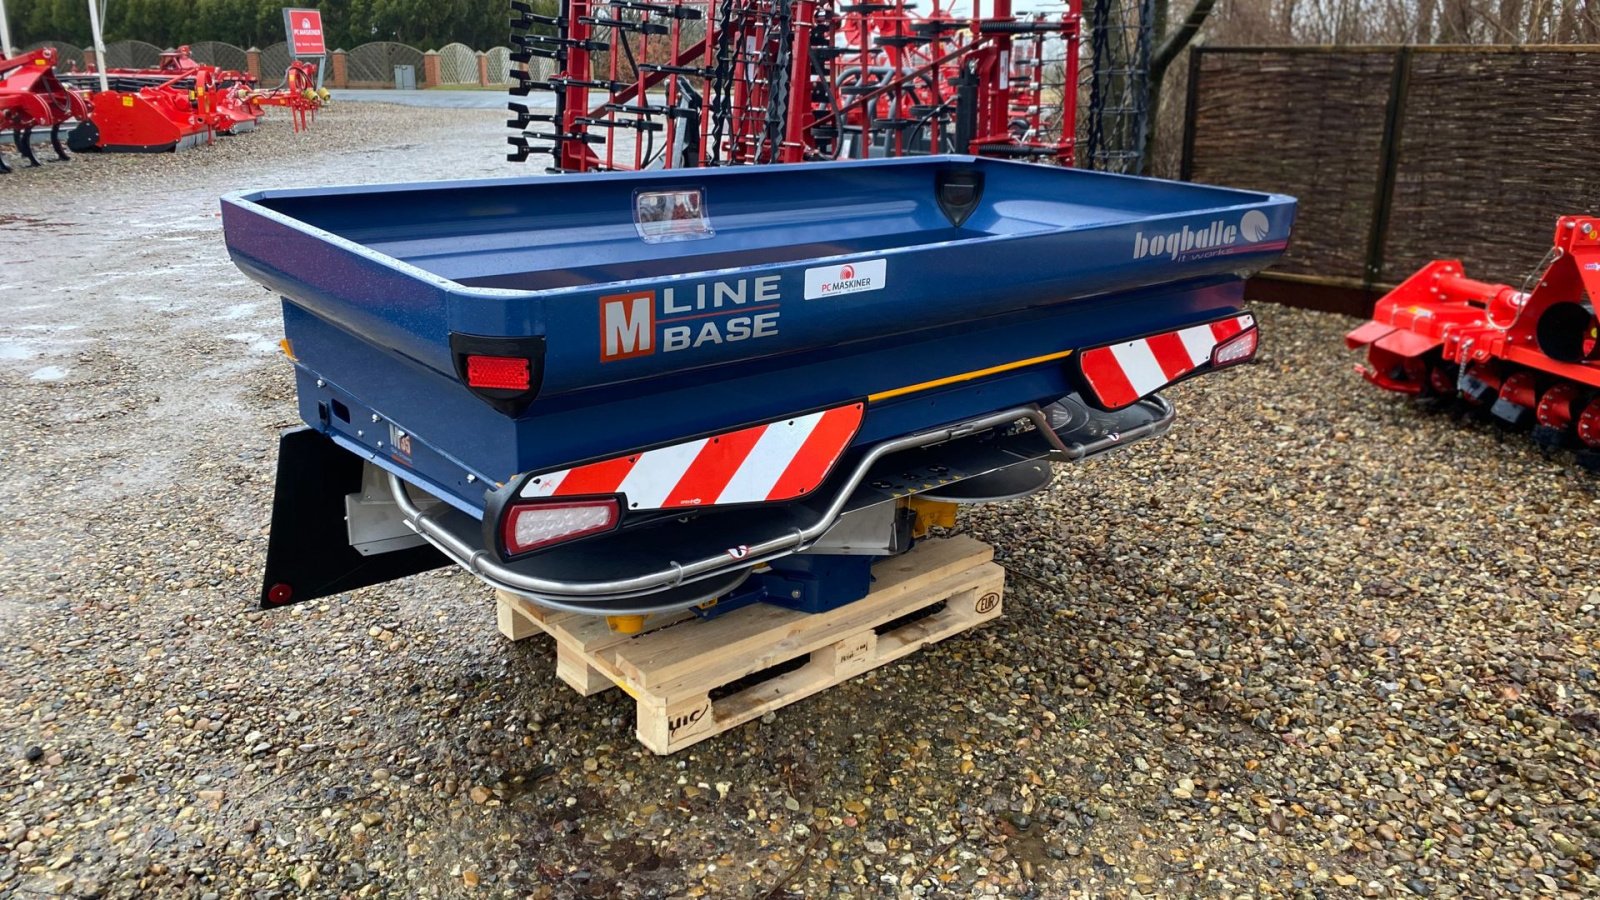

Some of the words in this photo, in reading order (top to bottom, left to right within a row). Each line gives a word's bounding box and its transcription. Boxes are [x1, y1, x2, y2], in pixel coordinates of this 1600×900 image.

[1133, 220, 1237, 260] bogballe
[663, 275, 781, 314] LINE
[821, 284, 831, 292] PC
[832, 278, 871, 290] MASKINER
[605, 297, 651, 356] M
[663, 312, 780, 352] BASE
[980, 595, 995, 611] EUR
